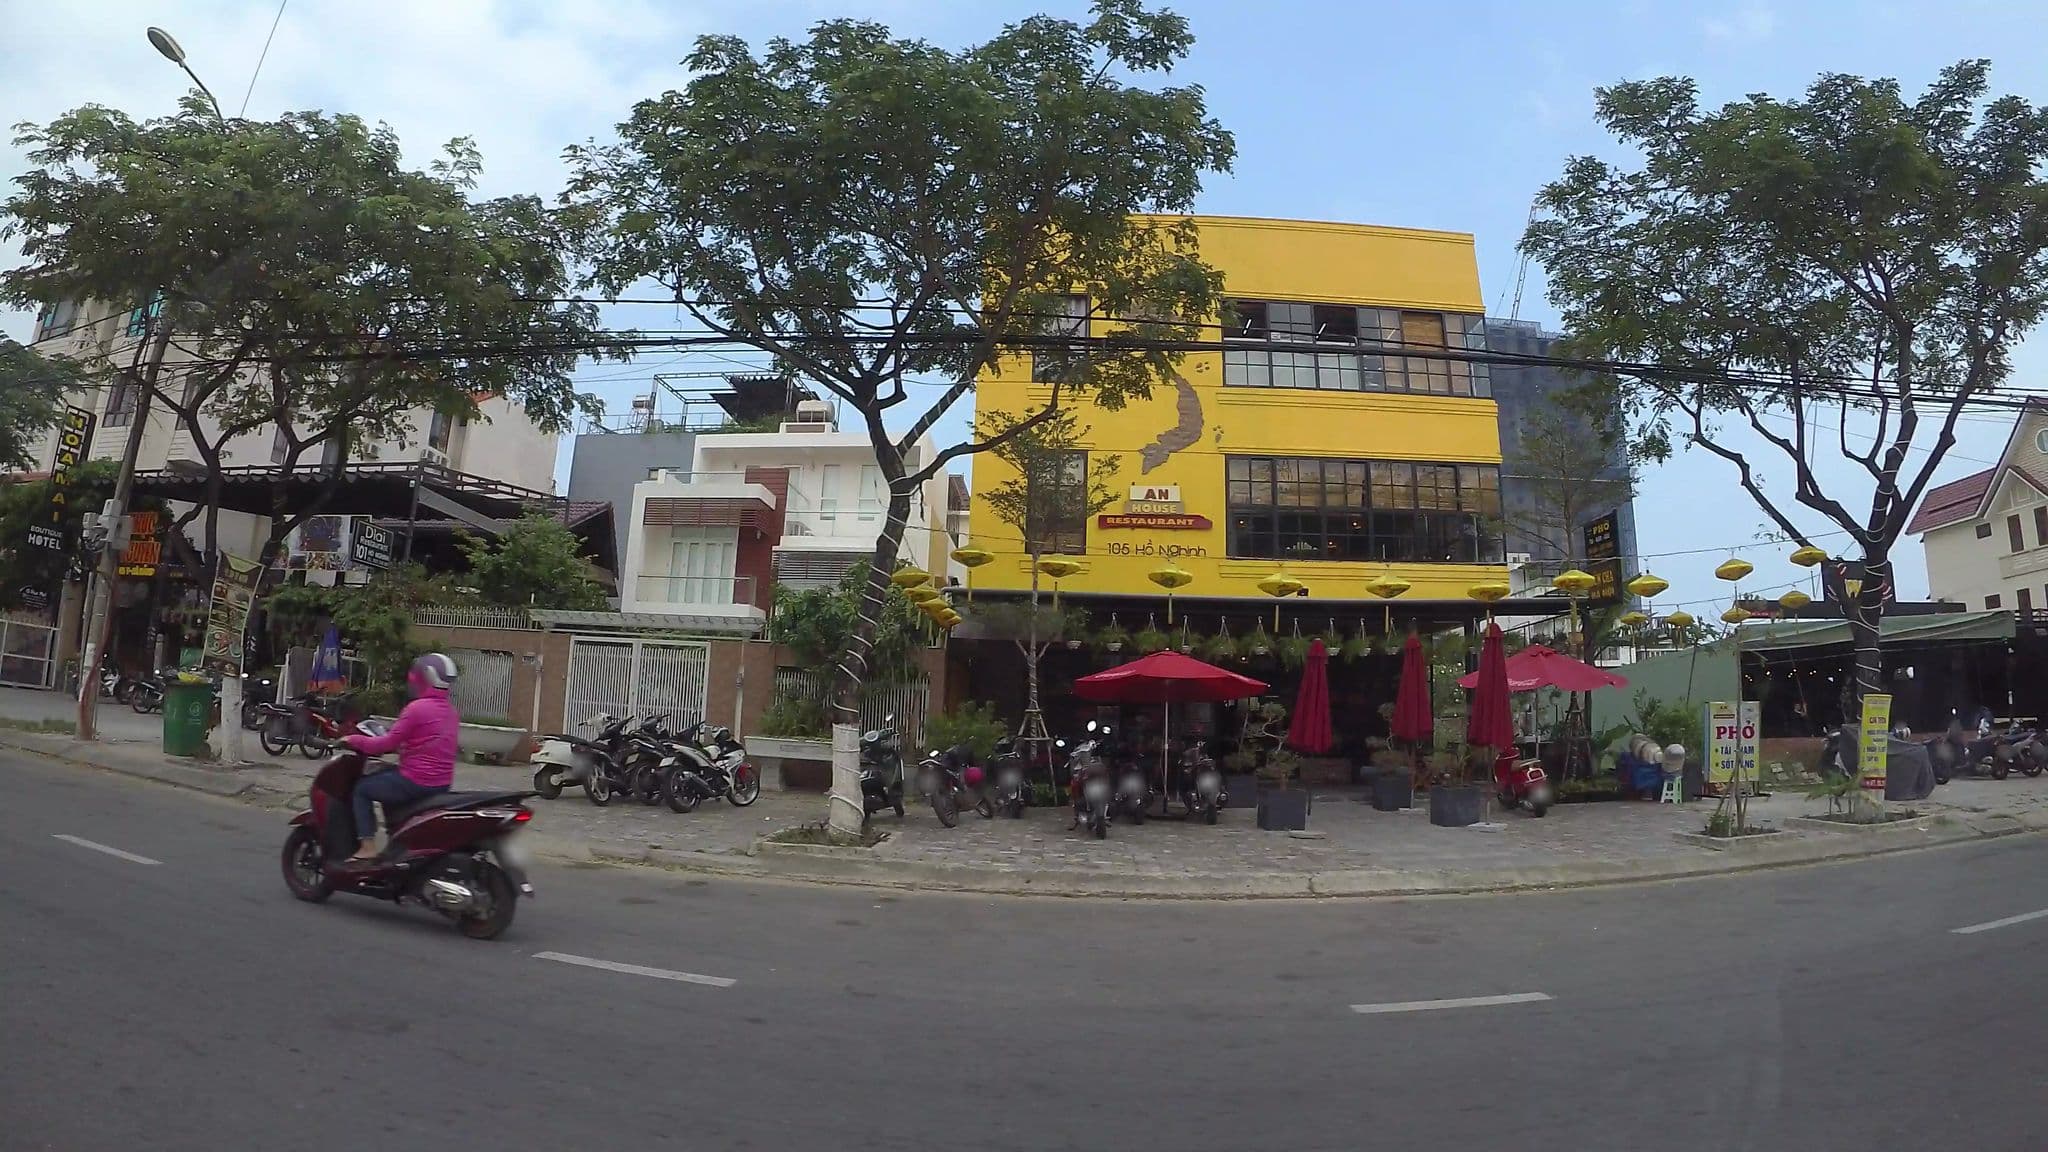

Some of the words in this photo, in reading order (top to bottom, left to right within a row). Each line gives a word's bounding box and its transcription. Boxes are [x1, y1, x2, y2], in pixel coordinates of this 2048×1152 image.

[1144, 488, 1169, 500] AN
[1131, 503, 1177, 514] HOUSE
[1106, 516, 1195, 526] RESTAURANT
[30, 525, 63, 538] BOUTIQUE
[27, 533, 61, 550] HOTEL
[1107, 542, 1129, 555] 105
[1135, 539, 1154, 556] Hồ
[1159, 544, 1207, 557] Nghinh
[356, 543, 368, 560] 101
[1715, 719, 1755, 740] PHỞ
